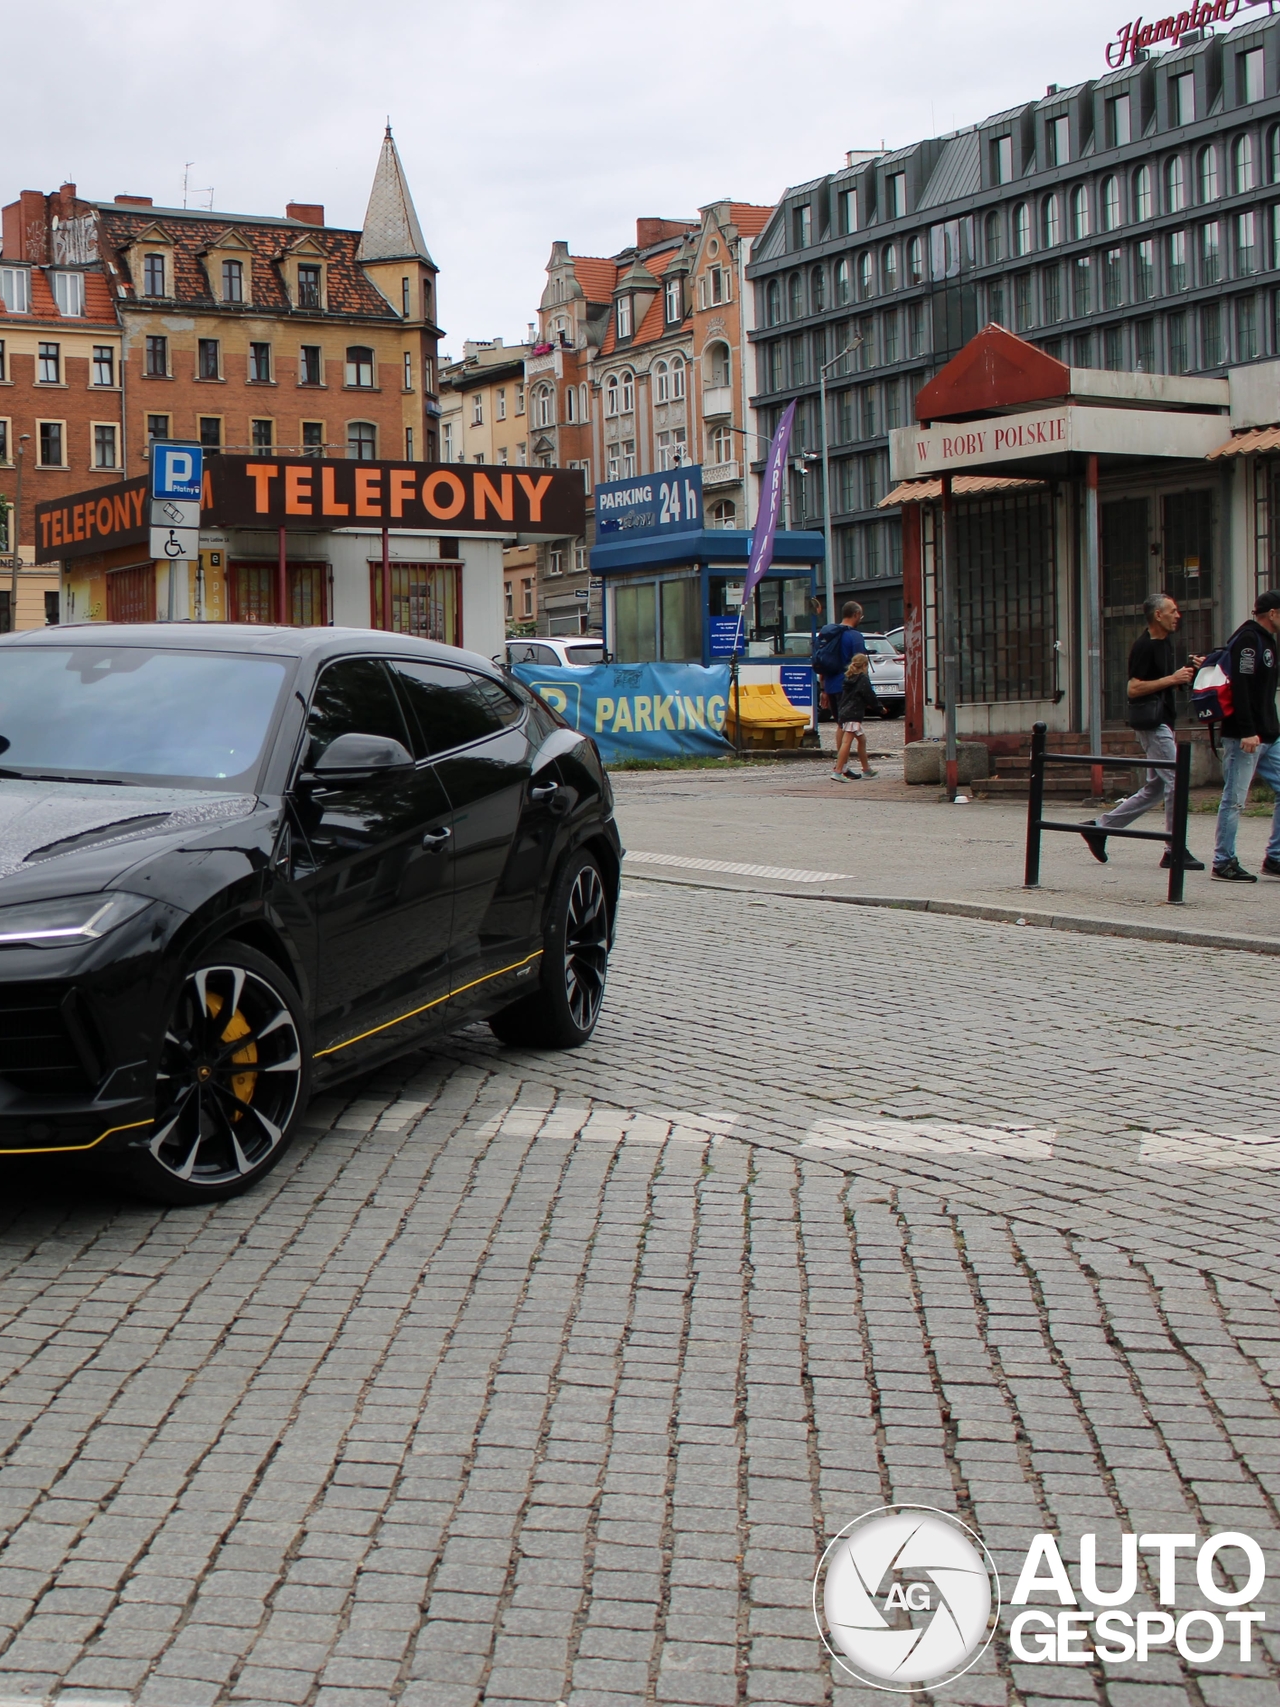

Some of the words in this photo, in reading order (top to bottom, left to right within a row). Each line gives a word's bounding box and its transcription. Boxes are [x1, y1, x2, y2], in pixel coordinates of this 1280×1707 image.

[1105, 0, 1240, 69] Hampton
[942, 429, 987, 458] ROBY
[994, 417, 1066, 451] POLSKIE
[165, 451, 193, 492] P
[245, 464, 555, 523] TELEFONY
[40, 487, 146, 549] TELEFONY
[599, 485, 652, 510] PARKING
[659, 480, 681, 524] 24
[685, 479, 697, 520] h
[595, 694, 726, 733] PARKING
